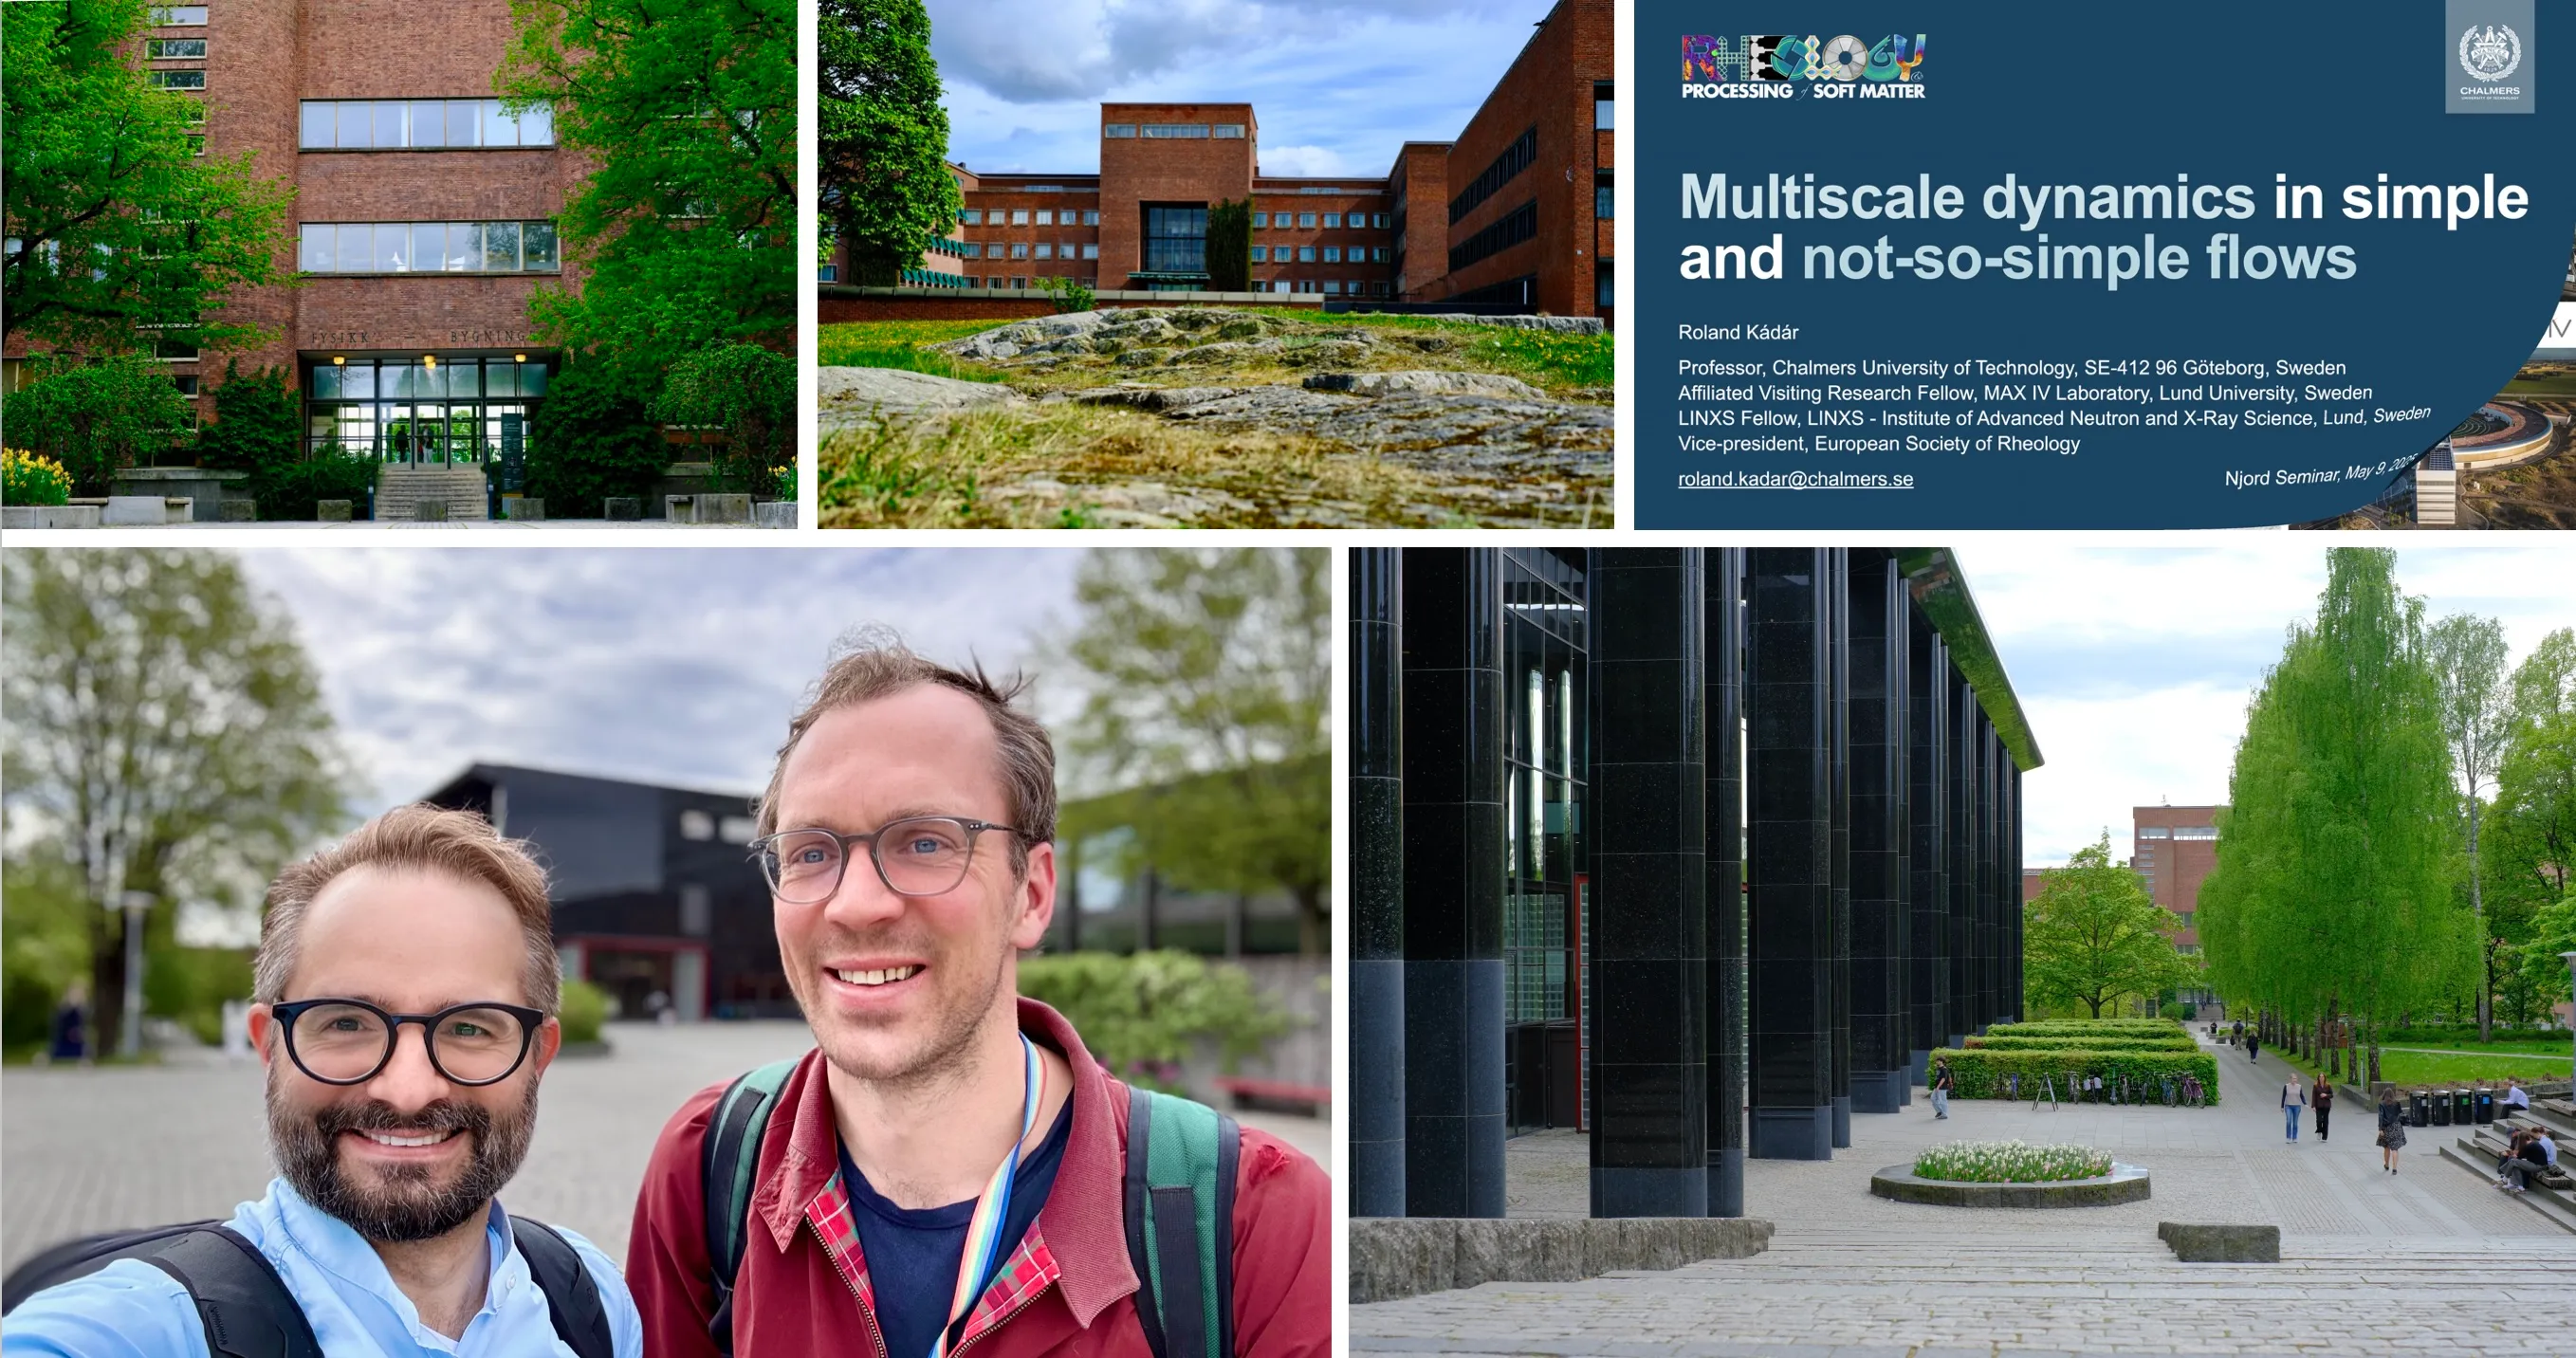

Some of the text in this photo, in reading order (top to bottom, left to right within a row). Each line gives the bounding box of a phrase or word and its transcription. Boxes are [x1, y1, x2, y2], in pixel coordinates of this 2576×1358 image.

[1682, 34, 1926, 82] RHEOLOGY
[1682, 83, 1794, 99] PROCESSING
[1813, 83, 1856, 99] SOFT
[1859, 83, 1926, 99] MATTER
[1682, 173, 2530, 232] Multiscale dynamics in simple
[1680, 232, 2358, 291] and not-so-simple flows
[311, 332, 370, 343] FYSIKK
[451, 331, 534, 342] BYGNING
[1679, 323, 1800, 340] Roland Kádár
[1679, 358, 2346, 379] Professor, Chalmers University of Technology, SE-412 96 Göteborg, Sweden
[1678, 384, 2373, 405] Affiliated Visiting Research Fellow, MAX IV Laboratory, Lund University, Sweden
[1679, 410, 1736, 426] LINXS
[1741, 410, 1801, 429] Fellow,
[1808, 410, 1865, 427] LINXS
[1883, 410, 1951, 427] Institute
[1956, 410, 1974, 427] of
[1976, 410, 2064, 427] Advanced
[2070, 410, 2140, 427] Neutron
[2144, 410, 2178, 427] and
[2183, 410, 2239, 430] X-Ray
[2243, 410, 2318, 429] Science,
[2323, 409, 2368, 426] Lund,
[2373, 406, 2432, 423] Sweden
[1678, 434, 2081, 455] Vice-president, European Society of Rheology
[1678, 470, 1915, 491] roland.kadar@chalmers.se
[2225, 470, 2271, 489] Njord
[2275, 468, 2341, 485] Seminar,
[2345, 465, 2375, 481] May
[2375, 461, 2385, 476] 9,
